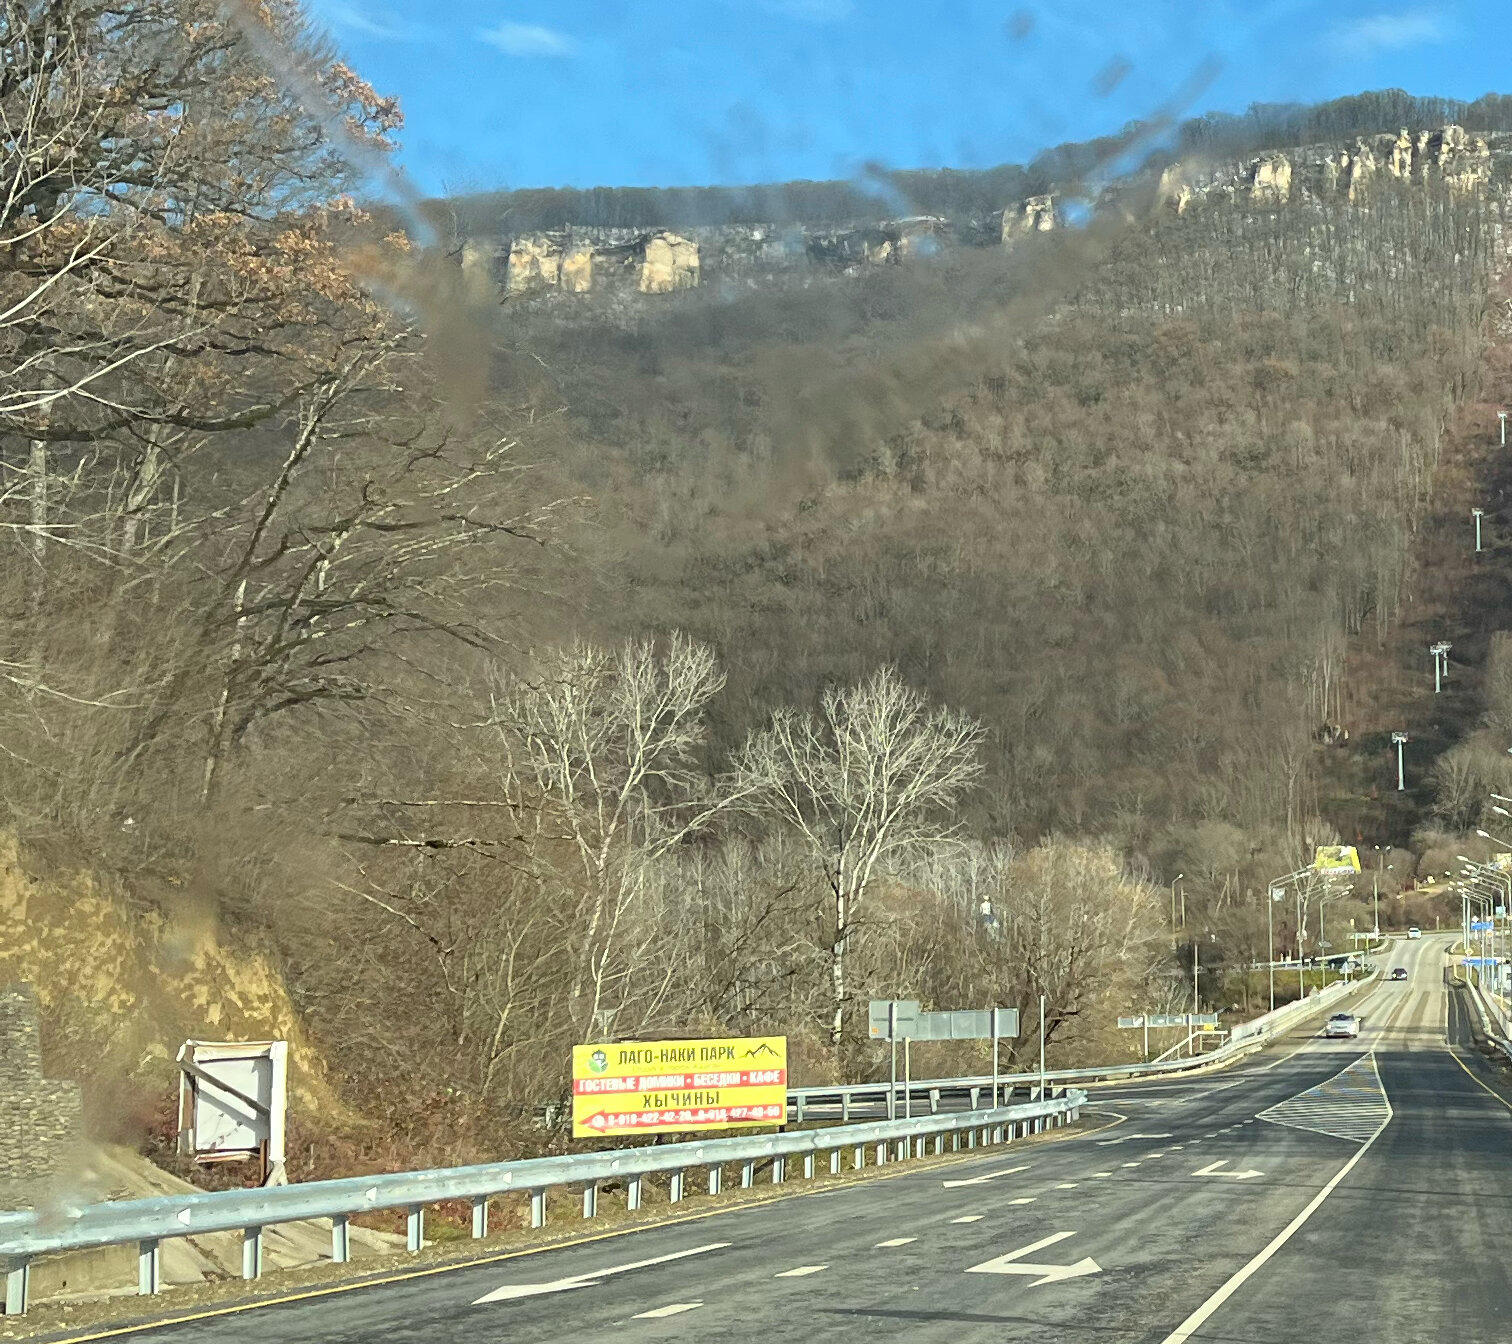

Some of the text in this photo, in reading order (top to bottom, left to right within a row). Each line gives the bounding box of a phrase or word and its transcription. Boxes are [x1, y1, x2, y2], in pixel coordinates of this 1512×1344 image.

[618, 1046, 736, 1065] ЛАГО-НАКИ ПАРК
[579, 1069, 780, 1092] ГОСТЕВЫЕ ДОМИКИ БЕСЕДКИ КАФЕ
[642, 1091, 720, 1108] ХЫЧИНЫ
